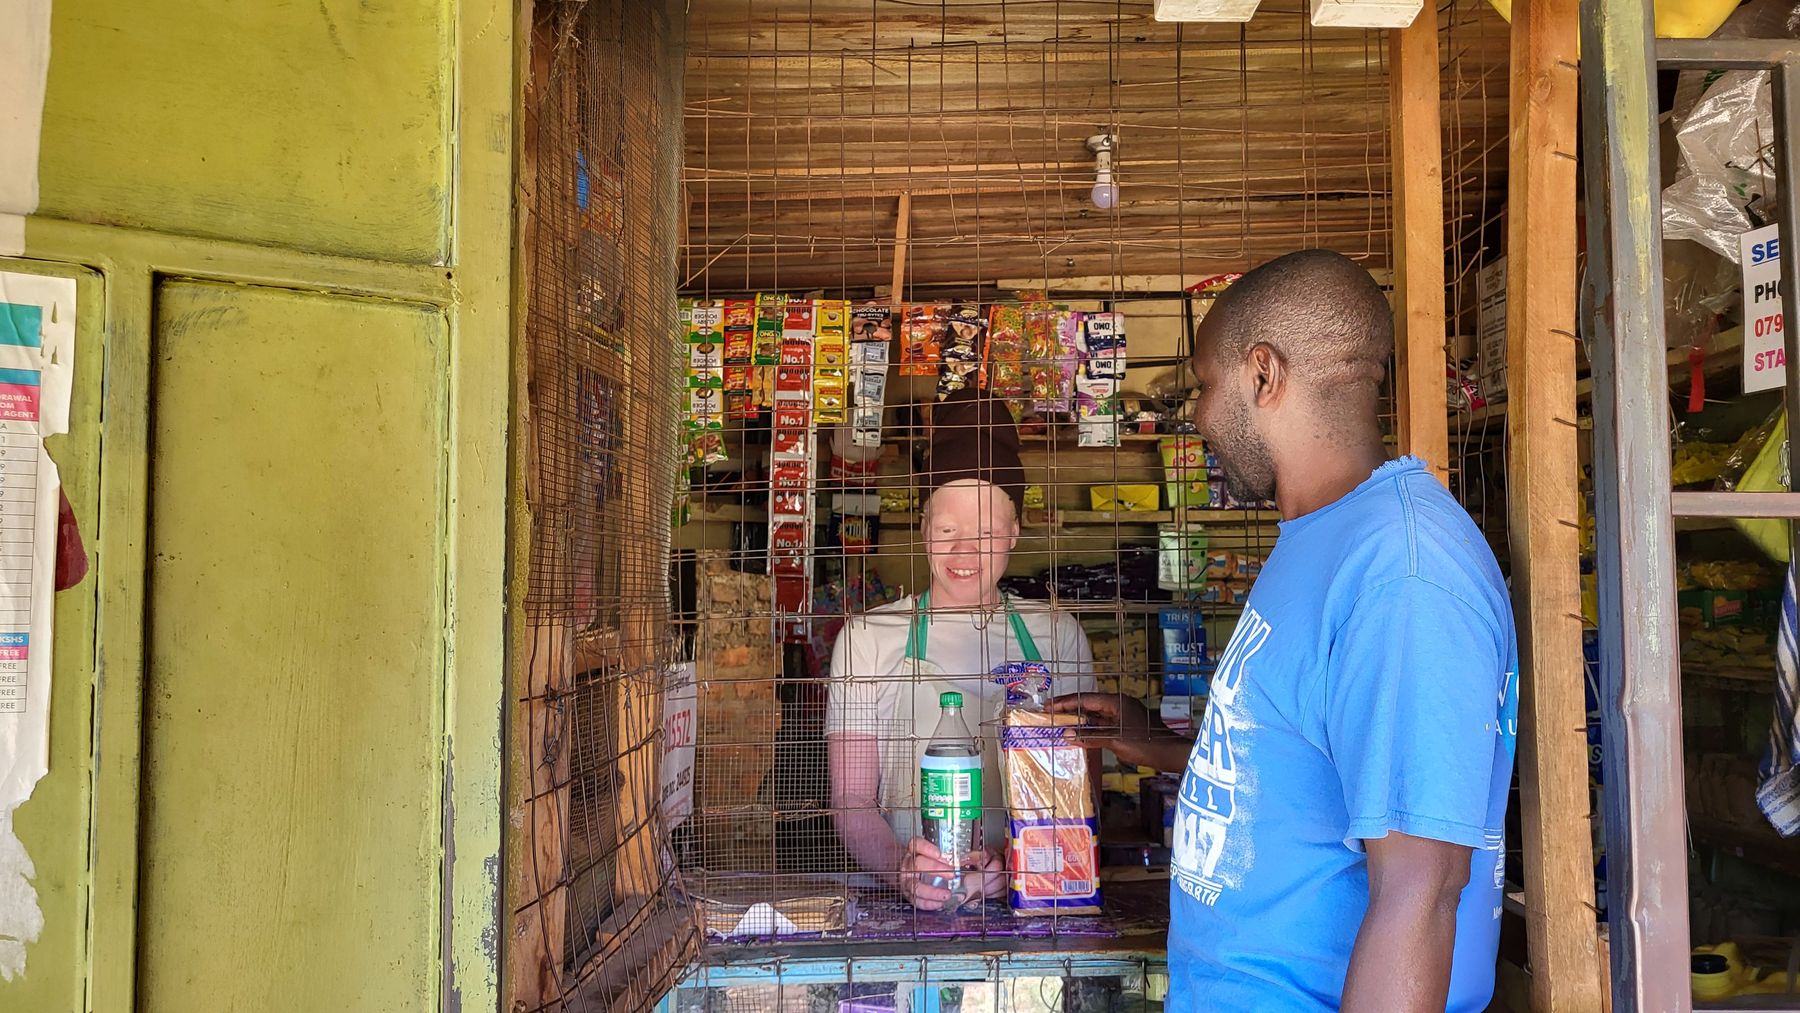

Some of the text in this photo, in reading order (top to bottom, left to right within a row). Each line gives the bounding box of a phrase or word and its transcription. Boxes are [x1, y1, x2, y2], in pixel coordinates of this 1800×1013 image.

[1755, 314, 1784, 338] 079
[783, 354, 804, 364] No.1
[0, 394, 33, 403] RAWAL
[4, 411, 35, 419] AGENT
[780, 415, 804, 425] No.1
[777, 539, 800, 548] No.1
[1167, 612, 1196, 622] TRUS
[1167, 642, 1204, 653] TRUST
